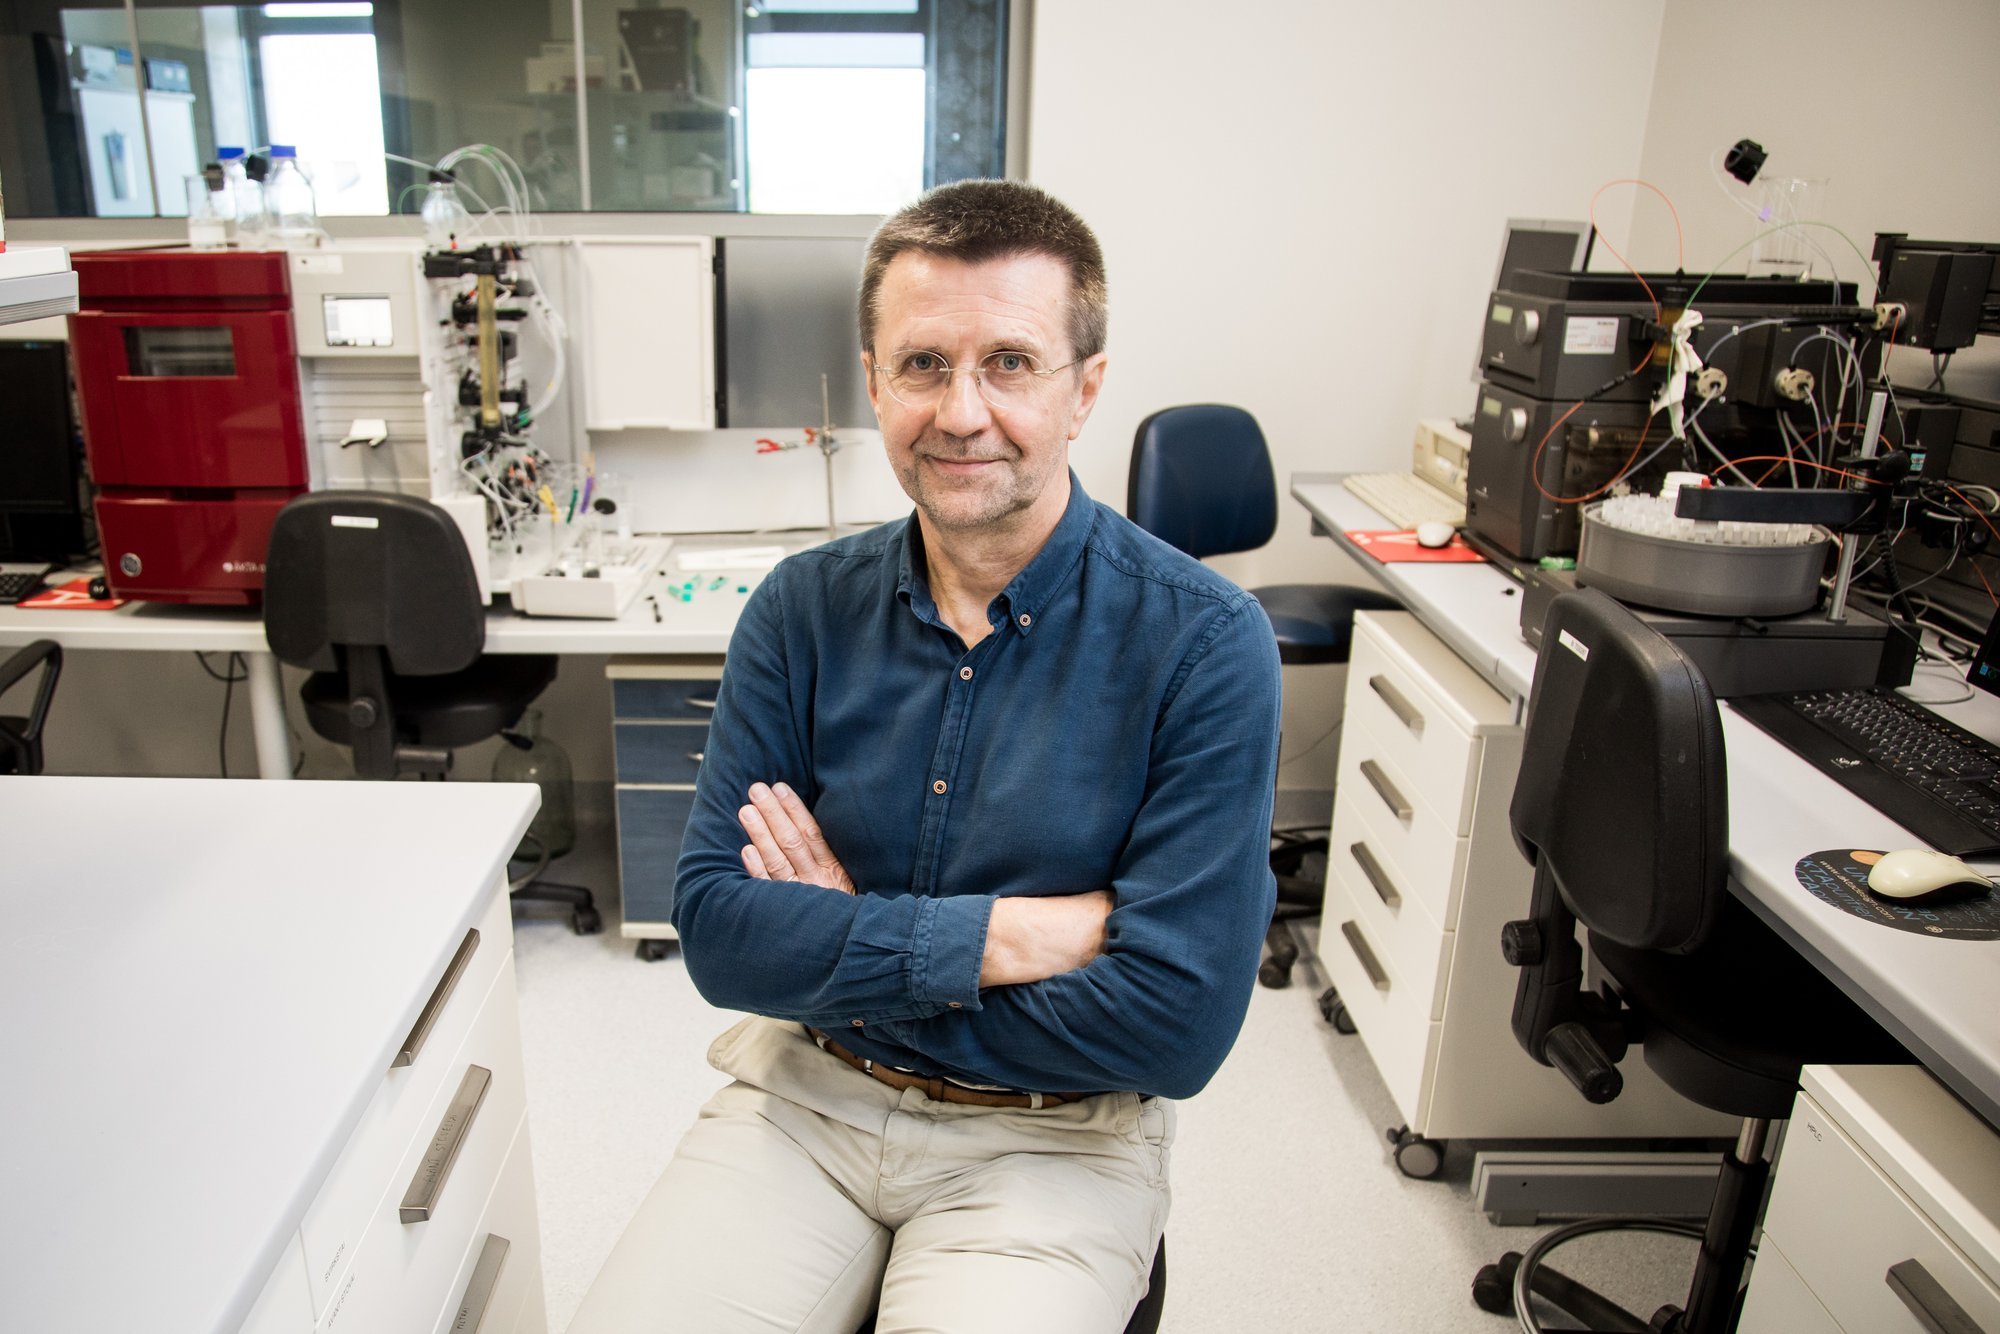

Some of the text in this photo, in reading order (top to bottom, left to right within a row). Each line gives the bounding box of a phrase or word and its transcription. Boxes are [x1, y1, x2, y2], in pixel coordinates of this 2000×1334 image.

[1799, 859, 1877, 920] KTApurifier
[1820, 860, 1895, 920] www.aktadesign.com
[1807, 1121, 1823, 1142] HPLC
